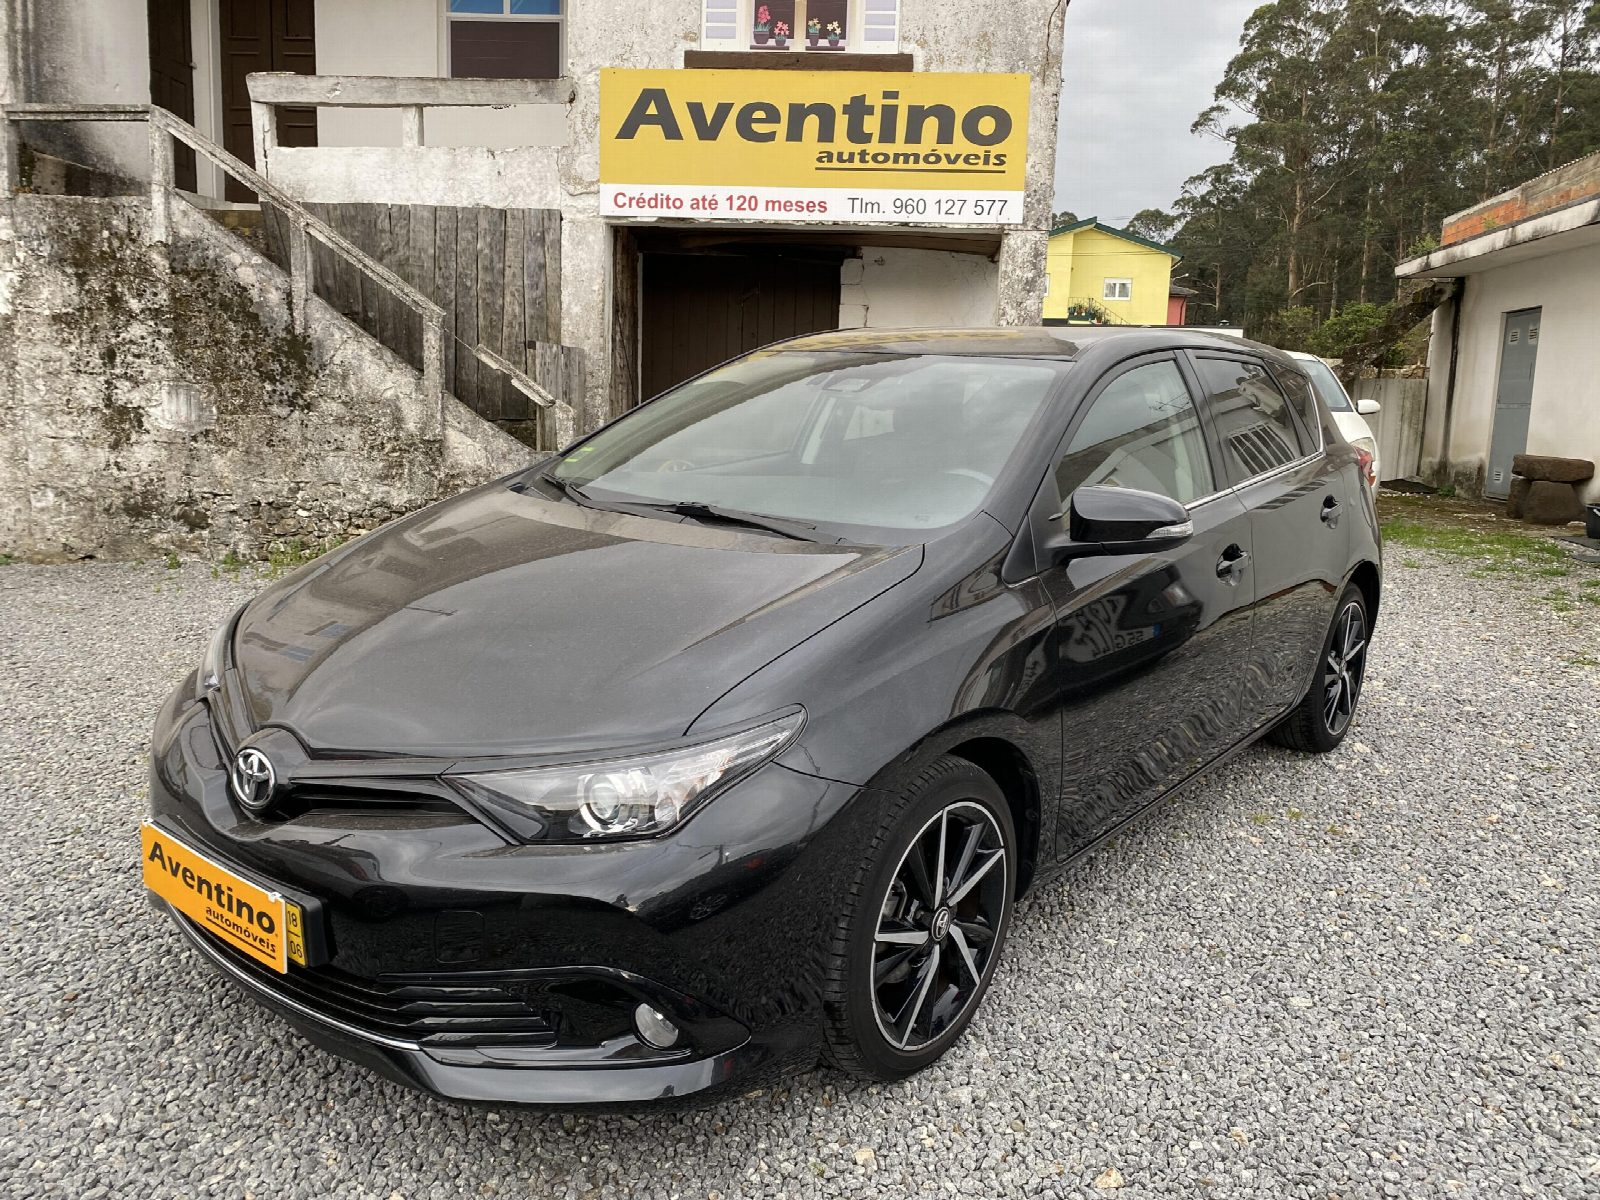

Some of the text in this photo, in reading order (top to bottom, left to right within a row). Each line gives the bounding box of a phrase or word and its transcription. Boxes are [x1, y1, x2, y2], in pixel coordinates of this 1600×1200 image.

[614, 88, 1012, 146] Aventino
[815, 148, 1008, 167] automóveis
[613, 191, 1008, 216] Crédito até 120 meses Tlm. 960 127 577
[148, 841, 276, 935] Aventino
[205, 906, 277, 954] automóveis
[287, 910, 298, 928] 18
